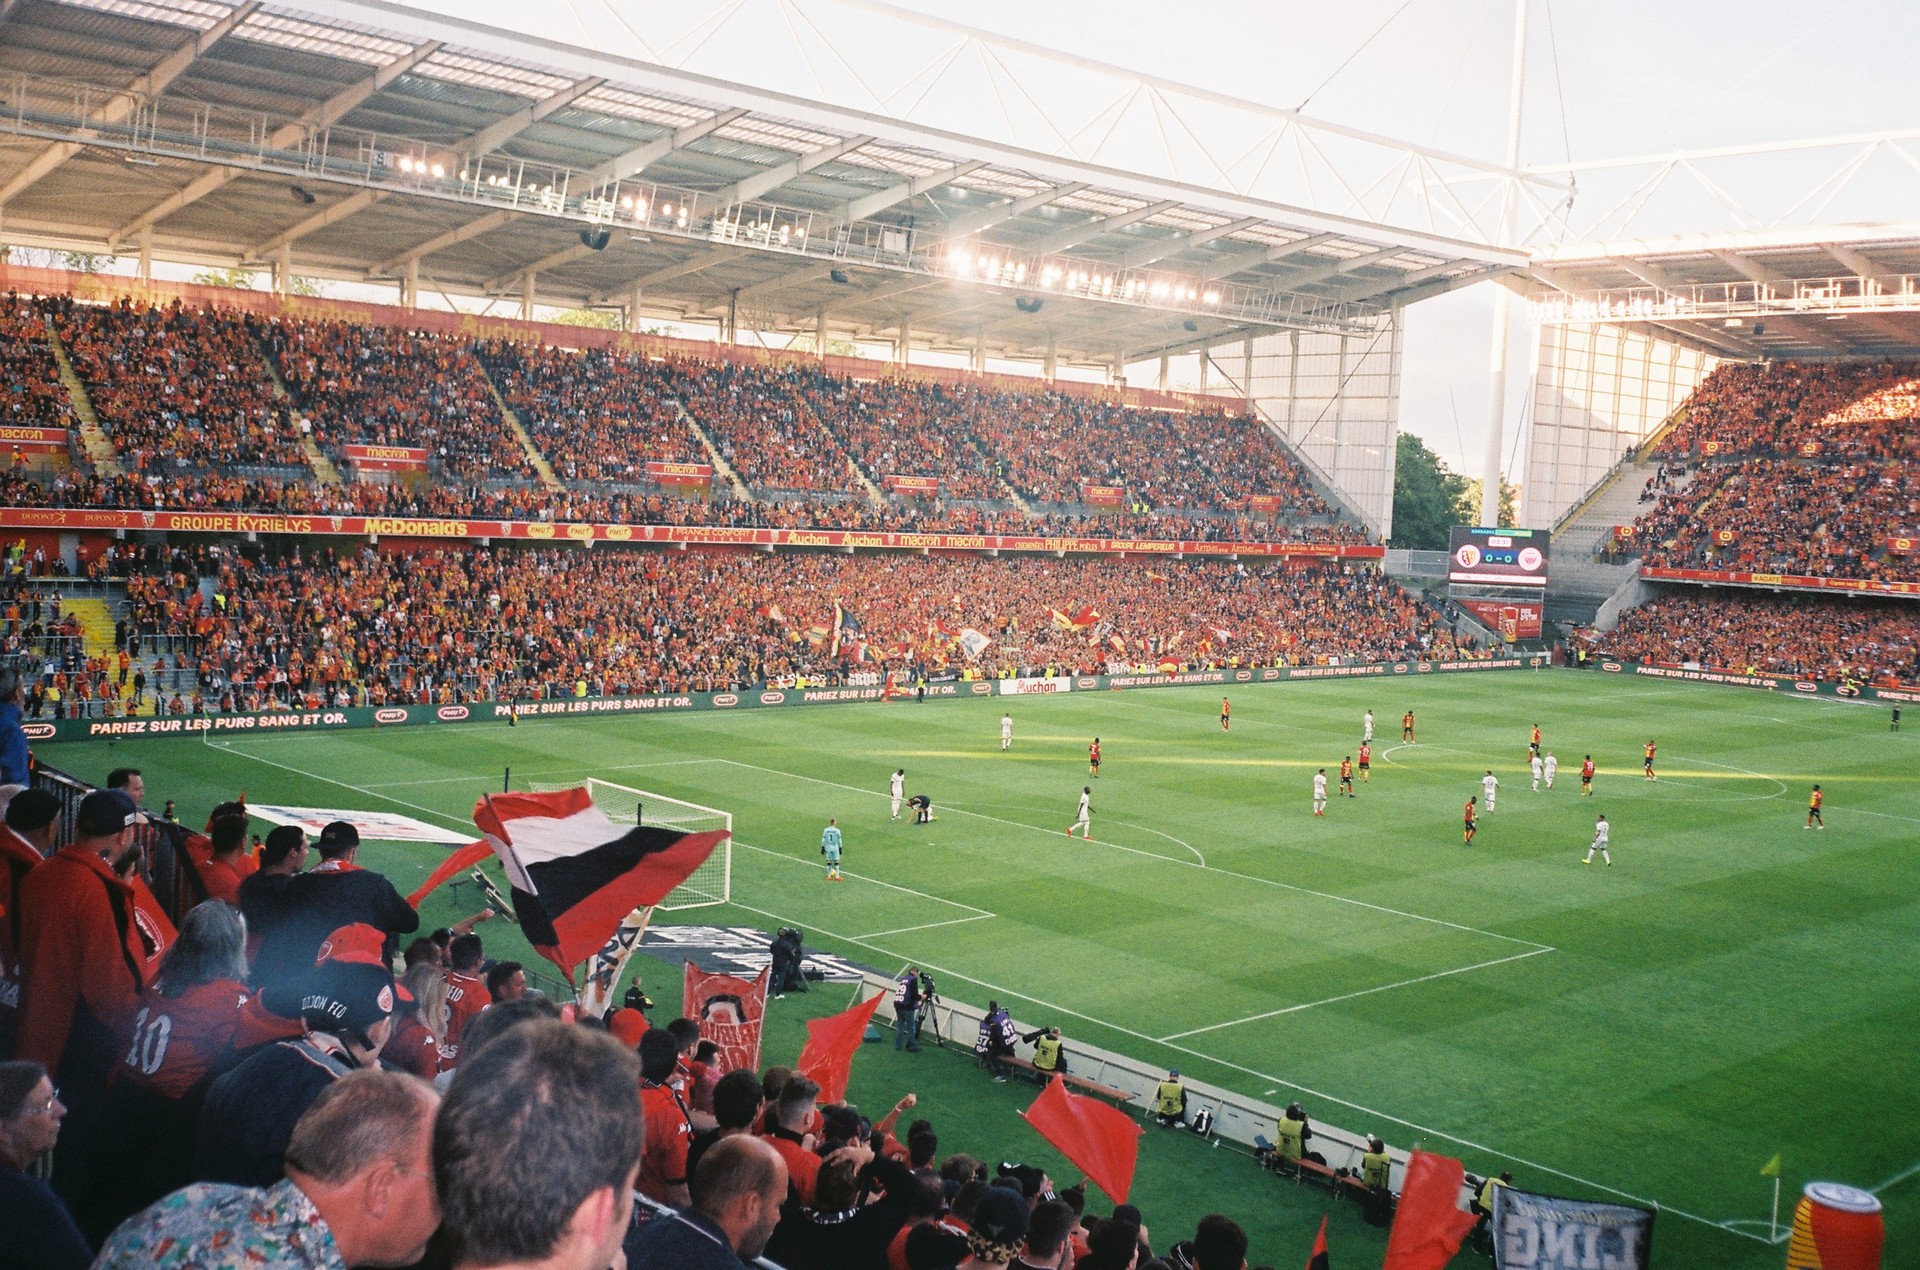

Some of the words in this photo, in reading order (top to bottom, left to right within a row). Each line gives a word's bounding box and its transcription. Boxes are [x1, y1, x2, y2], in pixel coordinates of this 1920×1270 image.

[367, 448, 410, 459] macron
[664, 465, 698, 475] macron
[899, 478, 927, 486] macron
[1091, 488, 1115, 496] macron
[85, 514, 117, 522] DUPONT
[171, 516, 233, 530] GROUPE
[237, 516, 312, 532] KYRIELYS
[364, 520, 468, 536] McDonald's
[677, 528, 709, 537] FRANCE
[712, 530, 750, 538] CONFORT
[787, 532, 830, 545] Auchan
[841, 532, 883, 546] Auchan
[901, 536, 940, 546] macron
[947, 537, 985, 547] macron
[1045, 539, 1078, 550] PHILIPPE
[1111, 541, 1134, 549] GROUPE
[1485, 554, 1493, 562] 0
[1504, 555, 1513, 563] 0
[1290, 669, 1310, 677] PARIEZ
[1350, 666, 1366, 674] SANG
[1110, 677, 1135, 686] PARIEZ
[1136, 677, 1150, 685] SUR
[1151, 676, 1164, 684] LES
[1184, 673, 1203, 682] SANG
[1203, 673, 1212, 681] ET
[1636, 667, 1665, 676] PARIEZ
[1666, 669, 1684, 678] SUR
[1685, 671, 1700, 679] LES
[1701, 673, 1723, 682] PURS
[1750, 678, 1762, 686] ET
[1763, 679, 1778, 688] OR.
[1017, 680, 1056, 692] Auchan
[804, 691, 838, 700] PARIEZ
[839, 690, 858, 699] SUR
[860, 689, 877, 698] LES
[928, 686, 940, 694] ET
[942, 686, 956, 694] OR.
[1877, 691, 1911, 700] PARIEZ
[495, 704, 539, 716] PARIEZ
[541, 703, 565, 713] SUR
[568, 701, 589, 712] LES
[591, 700, 621, 711] PURS
[624, 698, 655, 709] SANG
[657, 698, 672, 707] ET
[673, 696, 692, 707] OR.
[90, 721, 146, 735] PARIEZ
[150, 720, 182, 732] SUR
[186, 718, 212, 731] LES
[215, 716, 255, 729] PURS
[259, 715, 300, 727] SANG
[303, 713, 321, 725] ET
[323, 713, 347, 724] OR.
[302, 995, 328, 1010] DIJON
[327, 1001, 348, 1019] FCO
[125, 1007, 171, 1075] 10
[976, 1035, 990, 1047] 37
